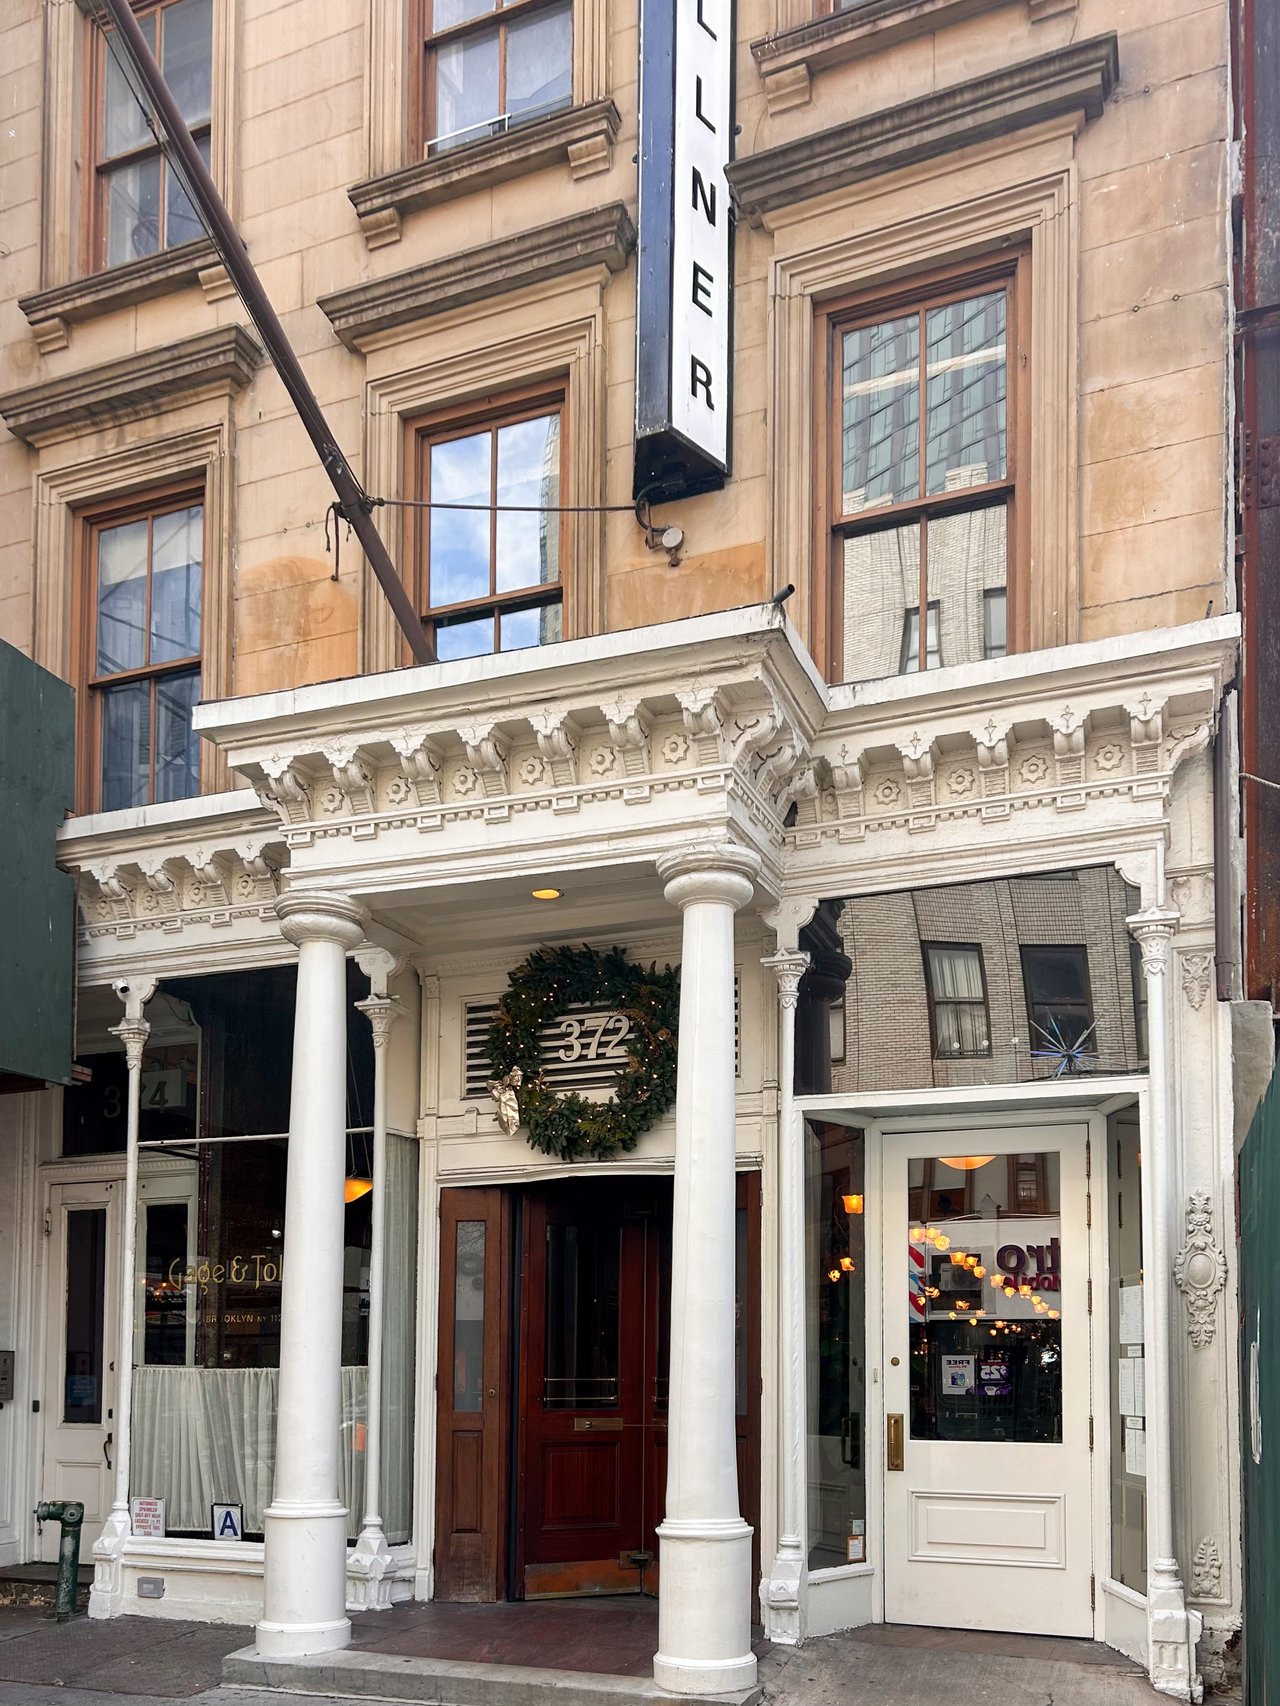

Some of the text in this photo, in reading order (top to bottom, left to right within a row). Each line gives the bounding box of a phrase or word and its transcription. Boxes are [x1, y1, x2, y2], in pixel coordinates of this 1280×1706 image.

[558, 1014, 631, 1063] 372
[103, 1080, 169, 1119] 34
[168, 1257, 226, 1295] Gage
[230, 1255, 249, 1283] &
[219, 1510, 239, 1537] A
